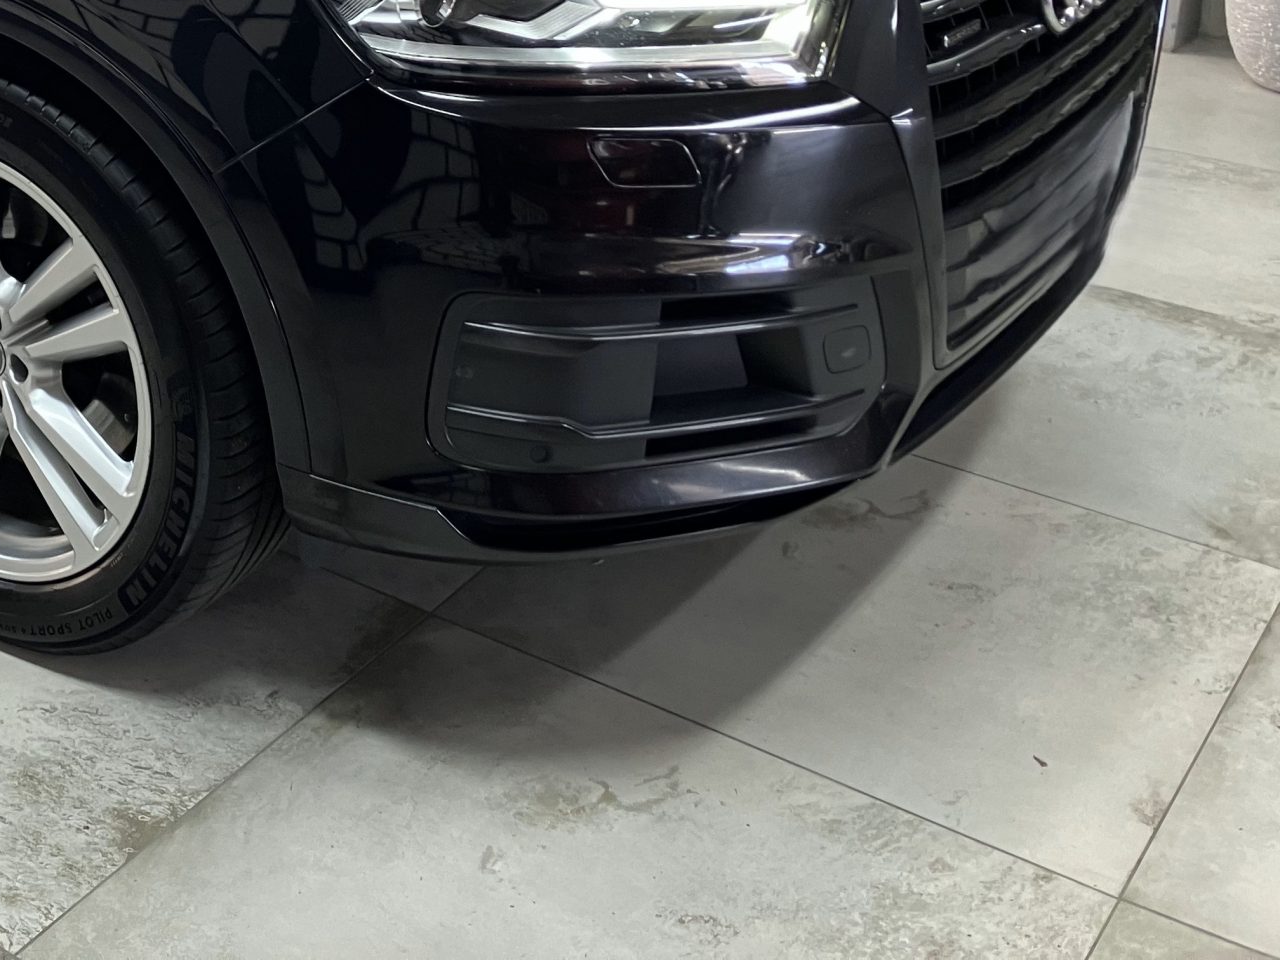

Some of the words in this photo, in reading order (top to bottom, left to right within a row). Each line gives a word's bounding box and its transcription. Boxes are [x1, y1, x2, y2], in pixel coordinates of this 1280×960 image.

[124, 431, 196, 607] MICHELIN
[30, 622, 72, 636] SPORT
[78, 608, 113, 631] PILOT
